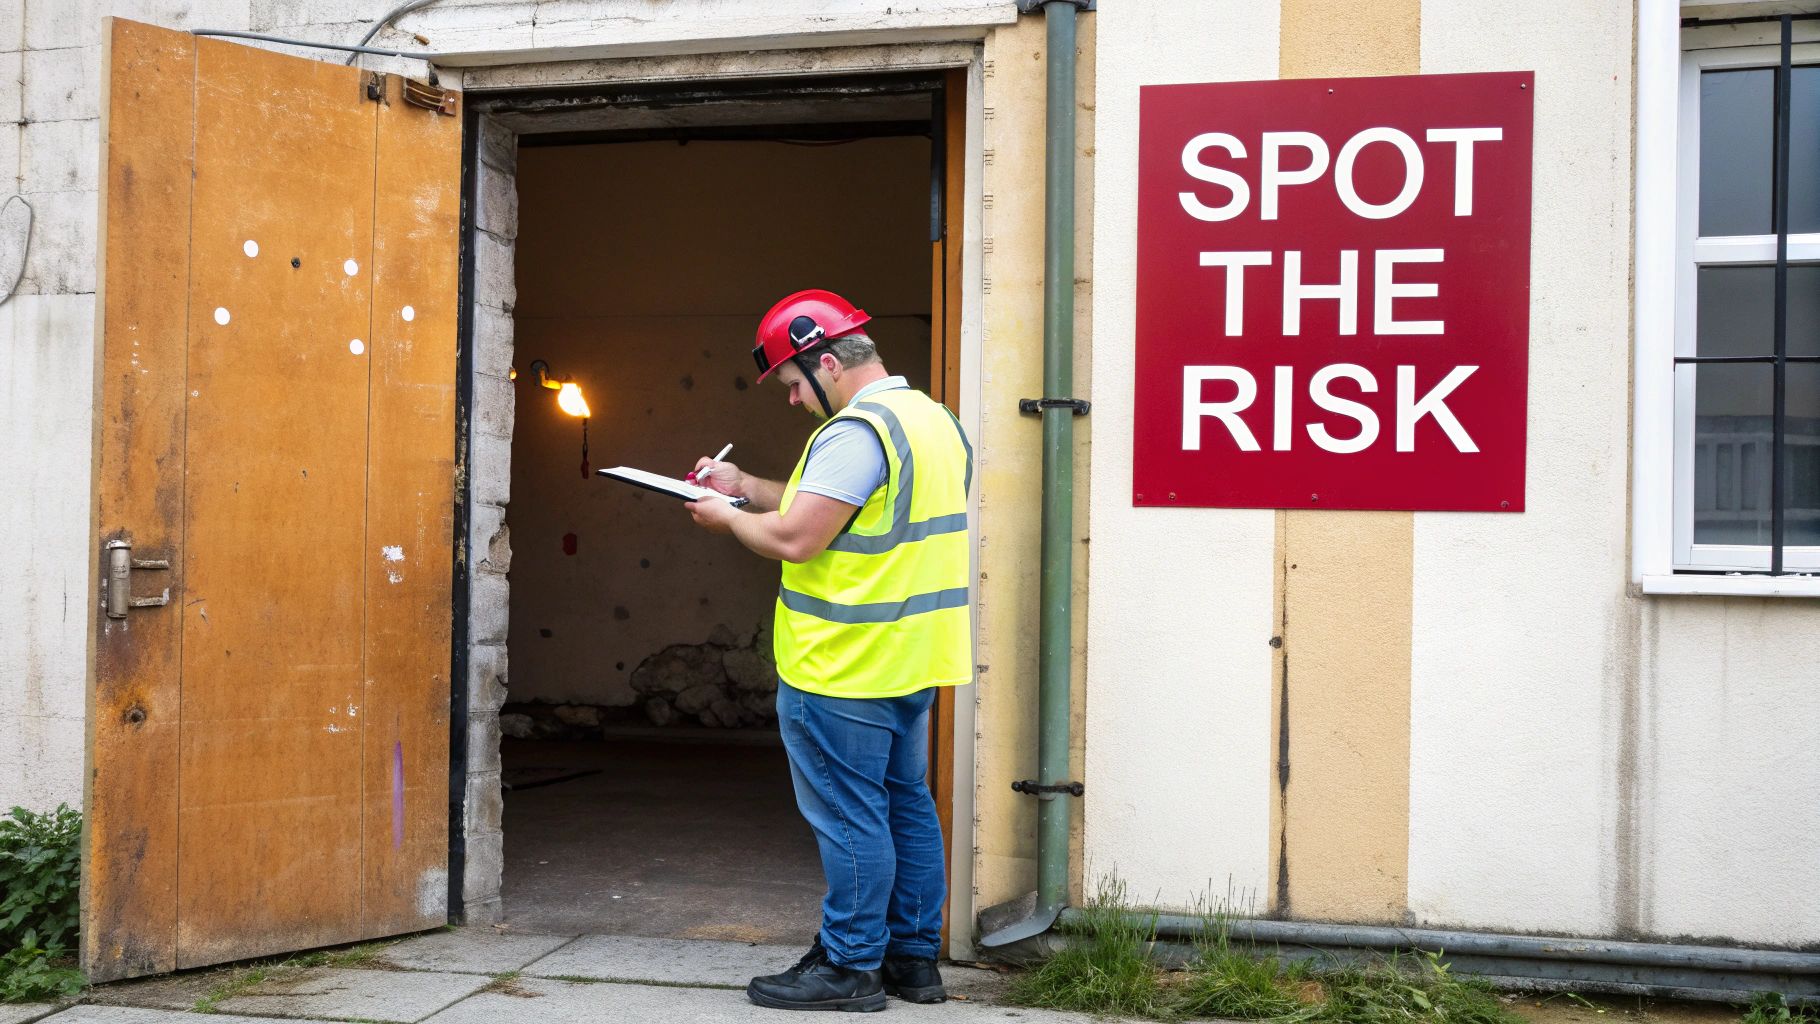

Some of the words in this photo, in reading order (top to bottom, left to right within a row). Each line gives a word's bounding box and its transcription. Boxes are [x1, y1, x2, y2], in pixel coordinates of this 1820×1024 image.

[1178, 126, 1503, 222] SPOT
[1199, 248, 1445, 337] THE
[1181, 362, 1481, 454] RISK
